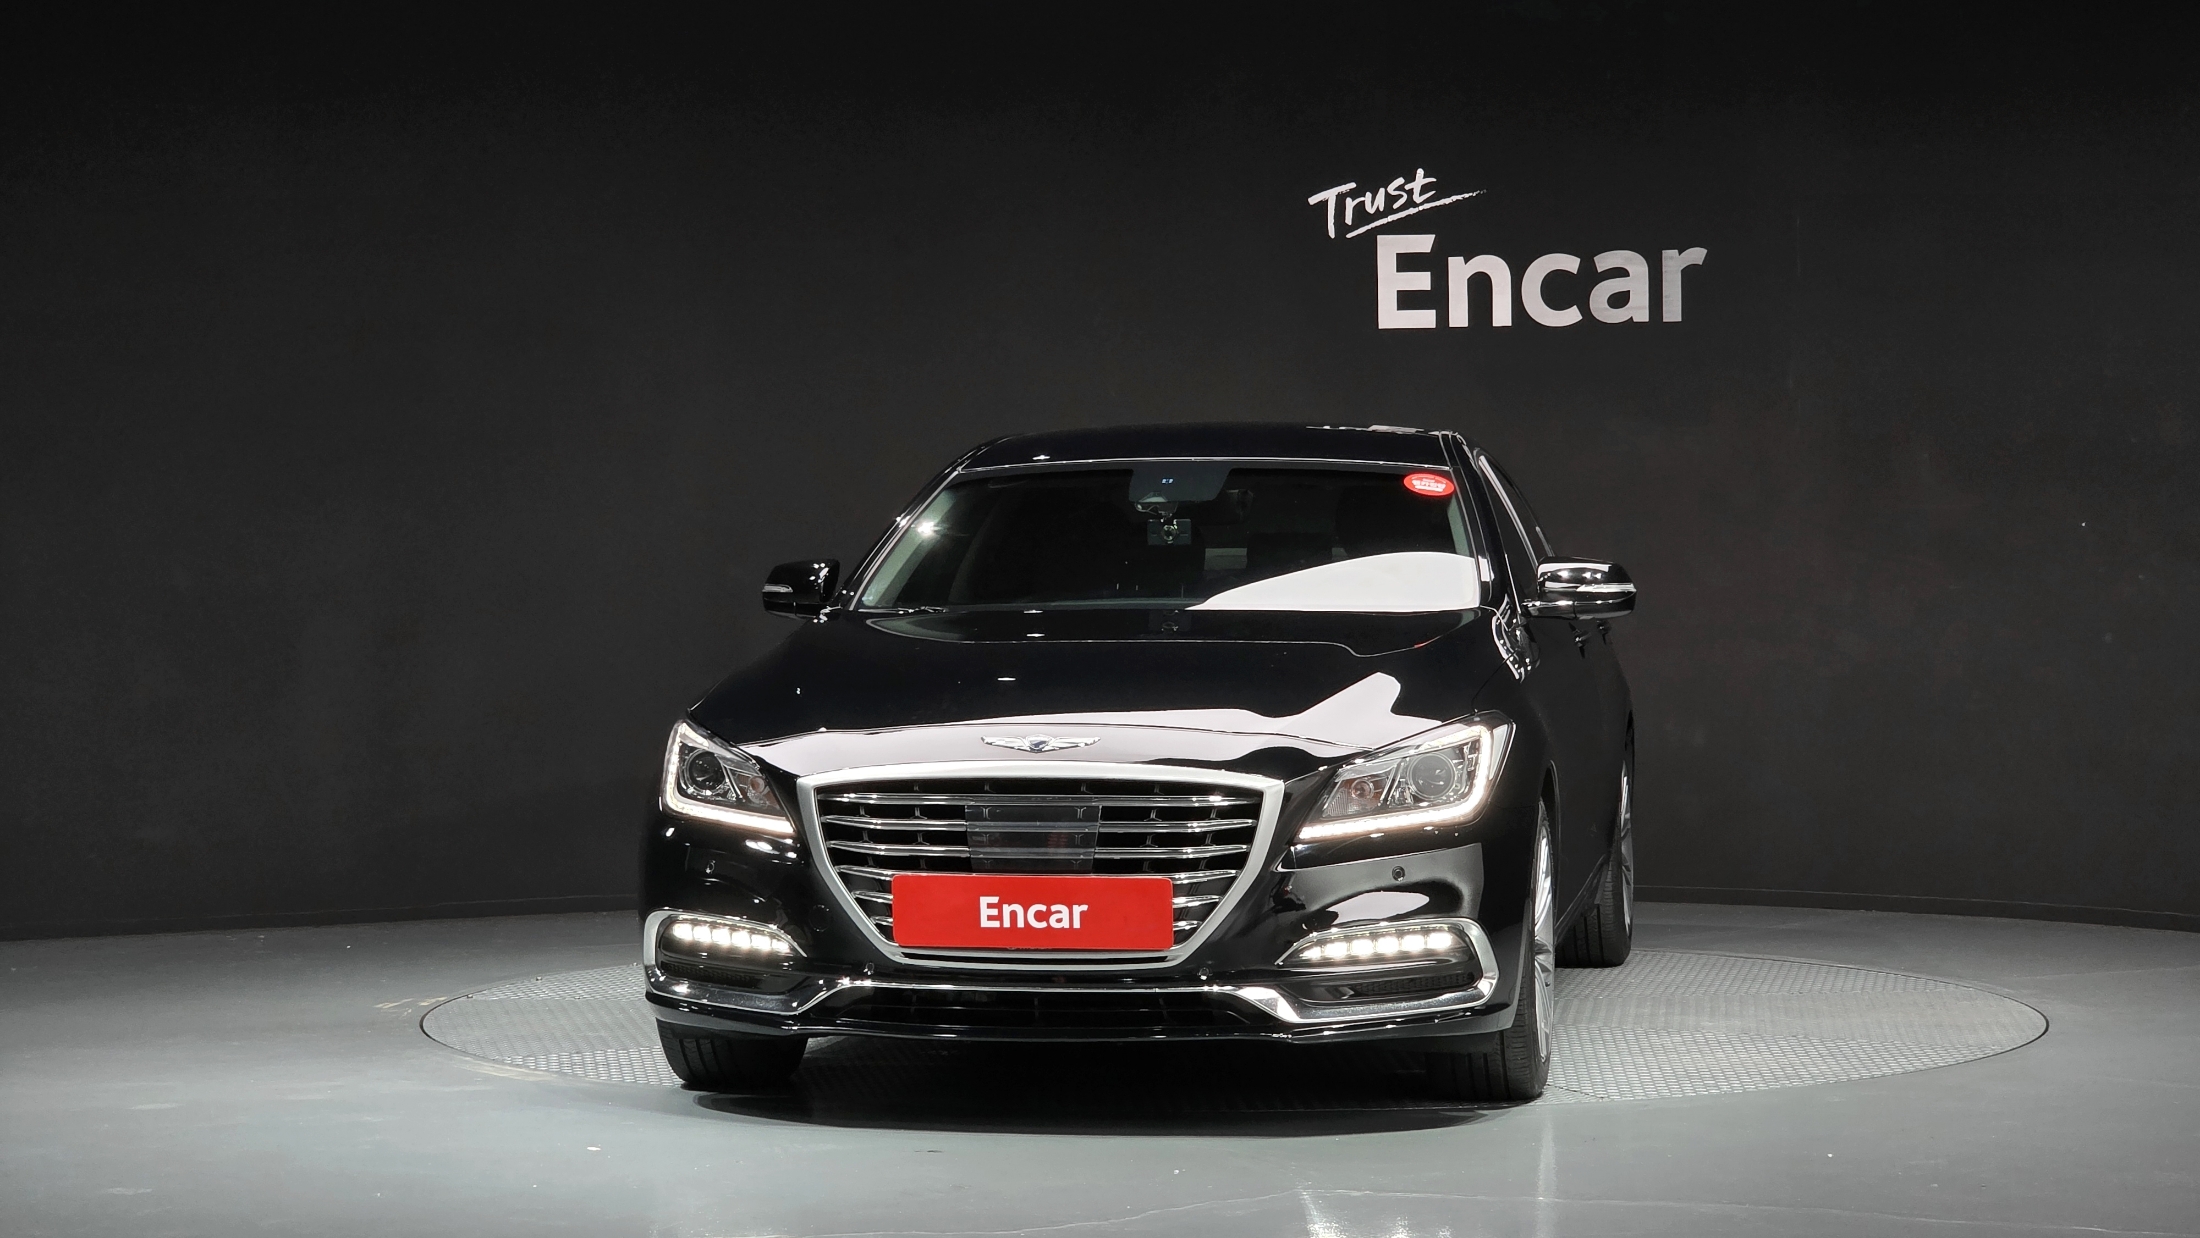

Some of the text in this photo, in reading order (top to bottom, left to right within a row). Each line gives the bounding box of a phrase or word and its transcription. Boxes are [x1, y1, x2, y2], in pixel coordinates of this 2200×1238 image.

[1308, 168, 1437, 239] Trust
[1377, 234, 1707, 329] Encar
[979, 896, 1089, 929] Encar
